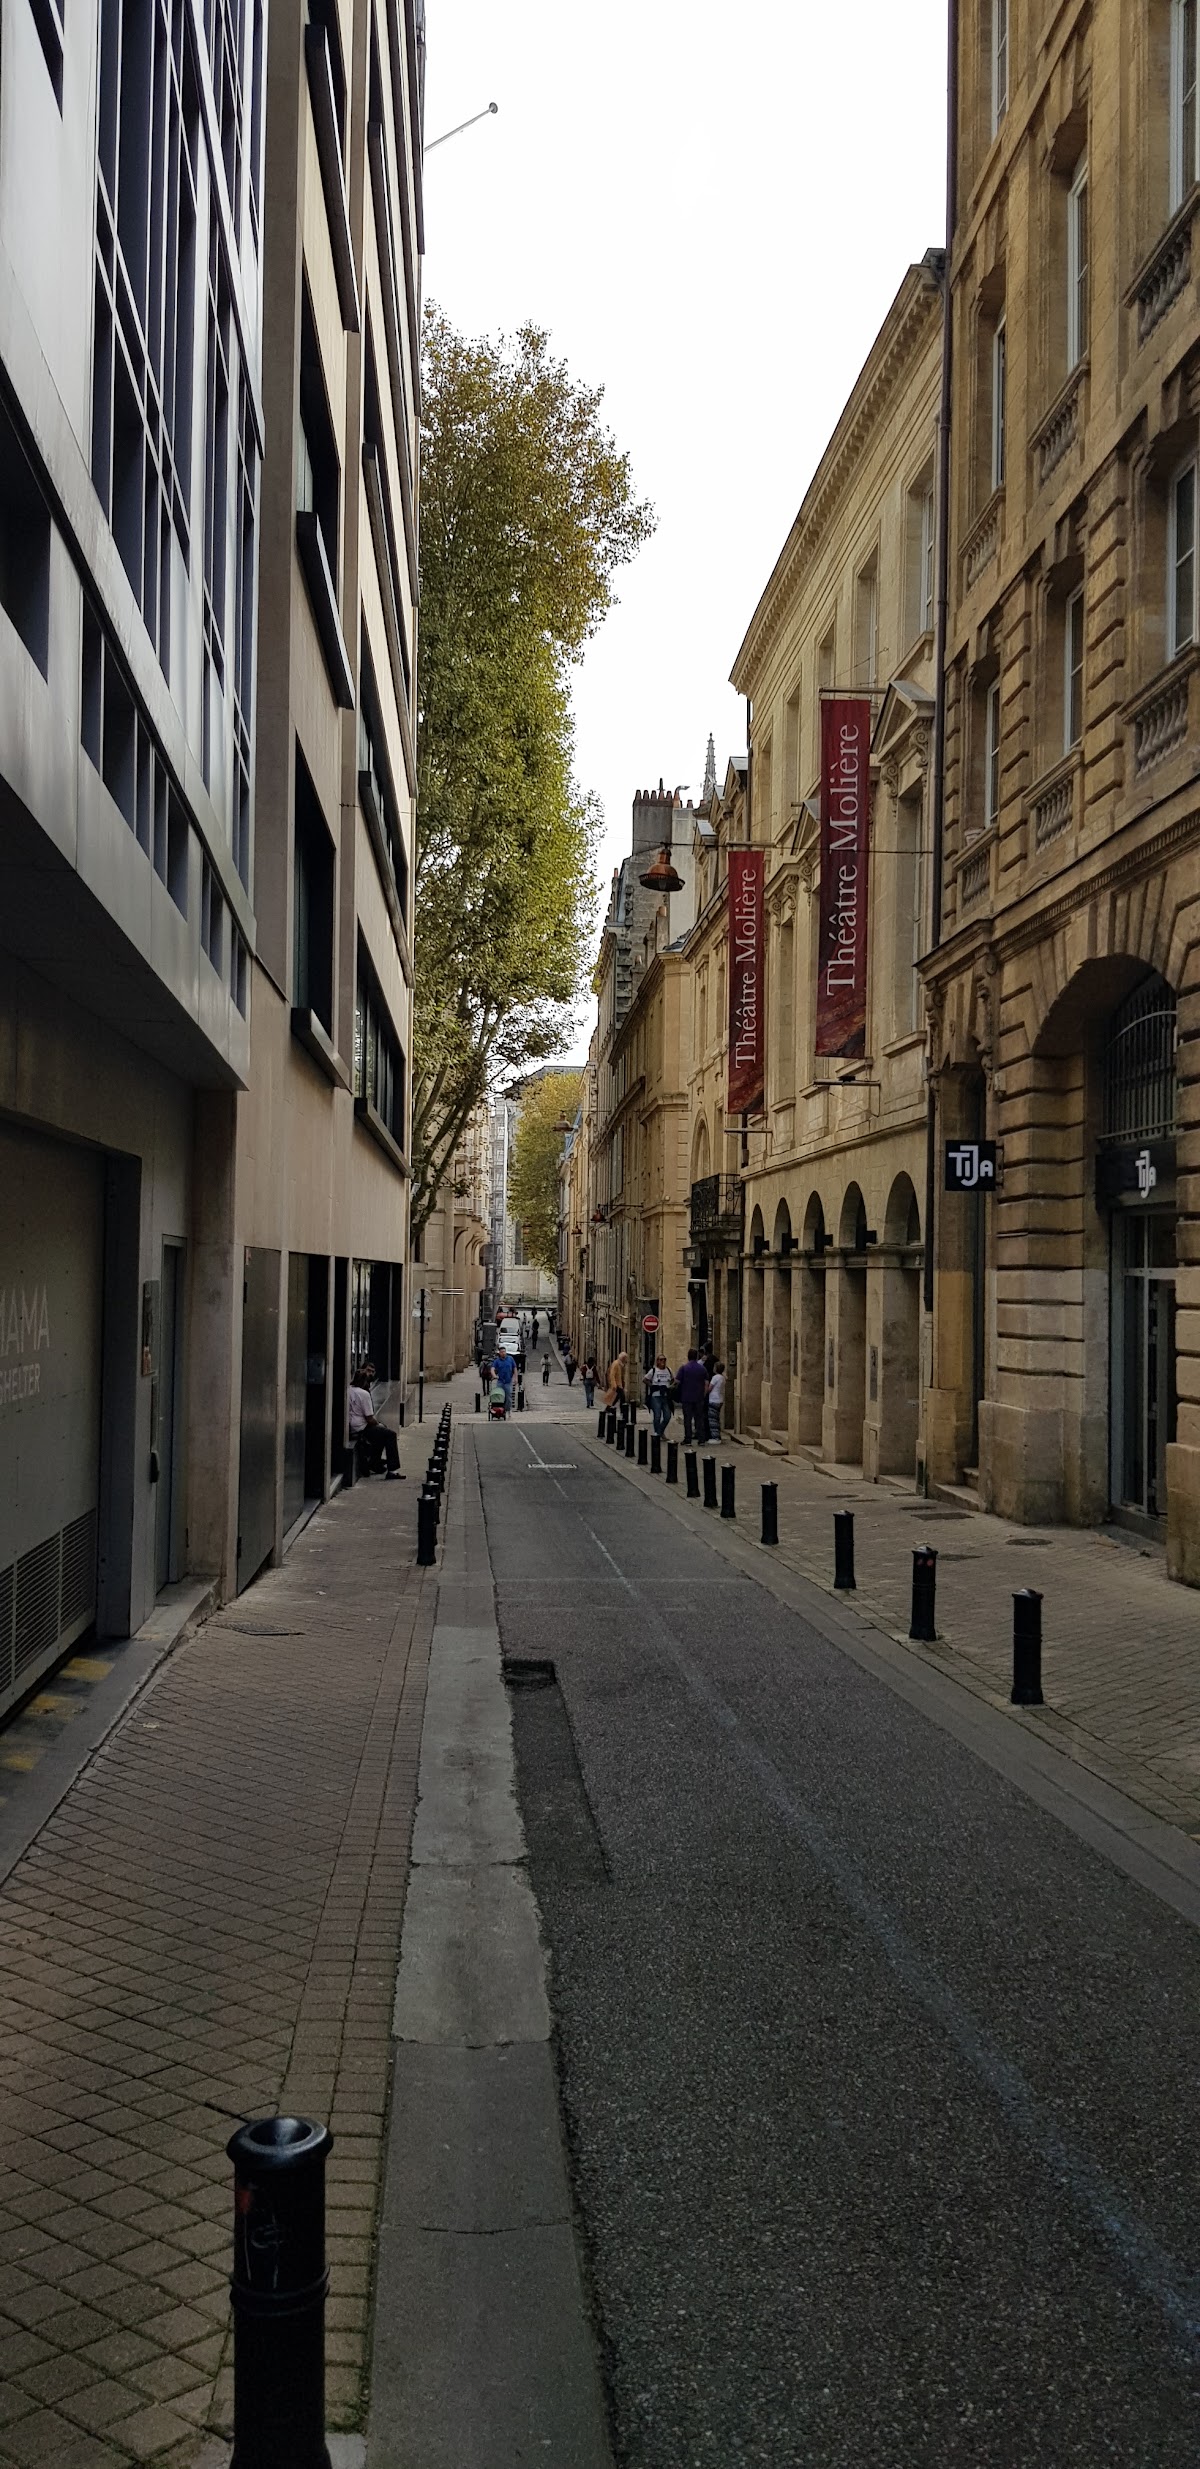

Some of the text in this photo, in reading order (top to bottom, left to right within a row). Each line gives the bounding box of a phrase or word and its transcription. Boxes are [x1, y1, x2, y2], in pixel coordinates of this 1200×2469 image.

[735, 868, 757, 1069] Théâtre Molière
[826, 724, 859, 996] Théâtre Molière
